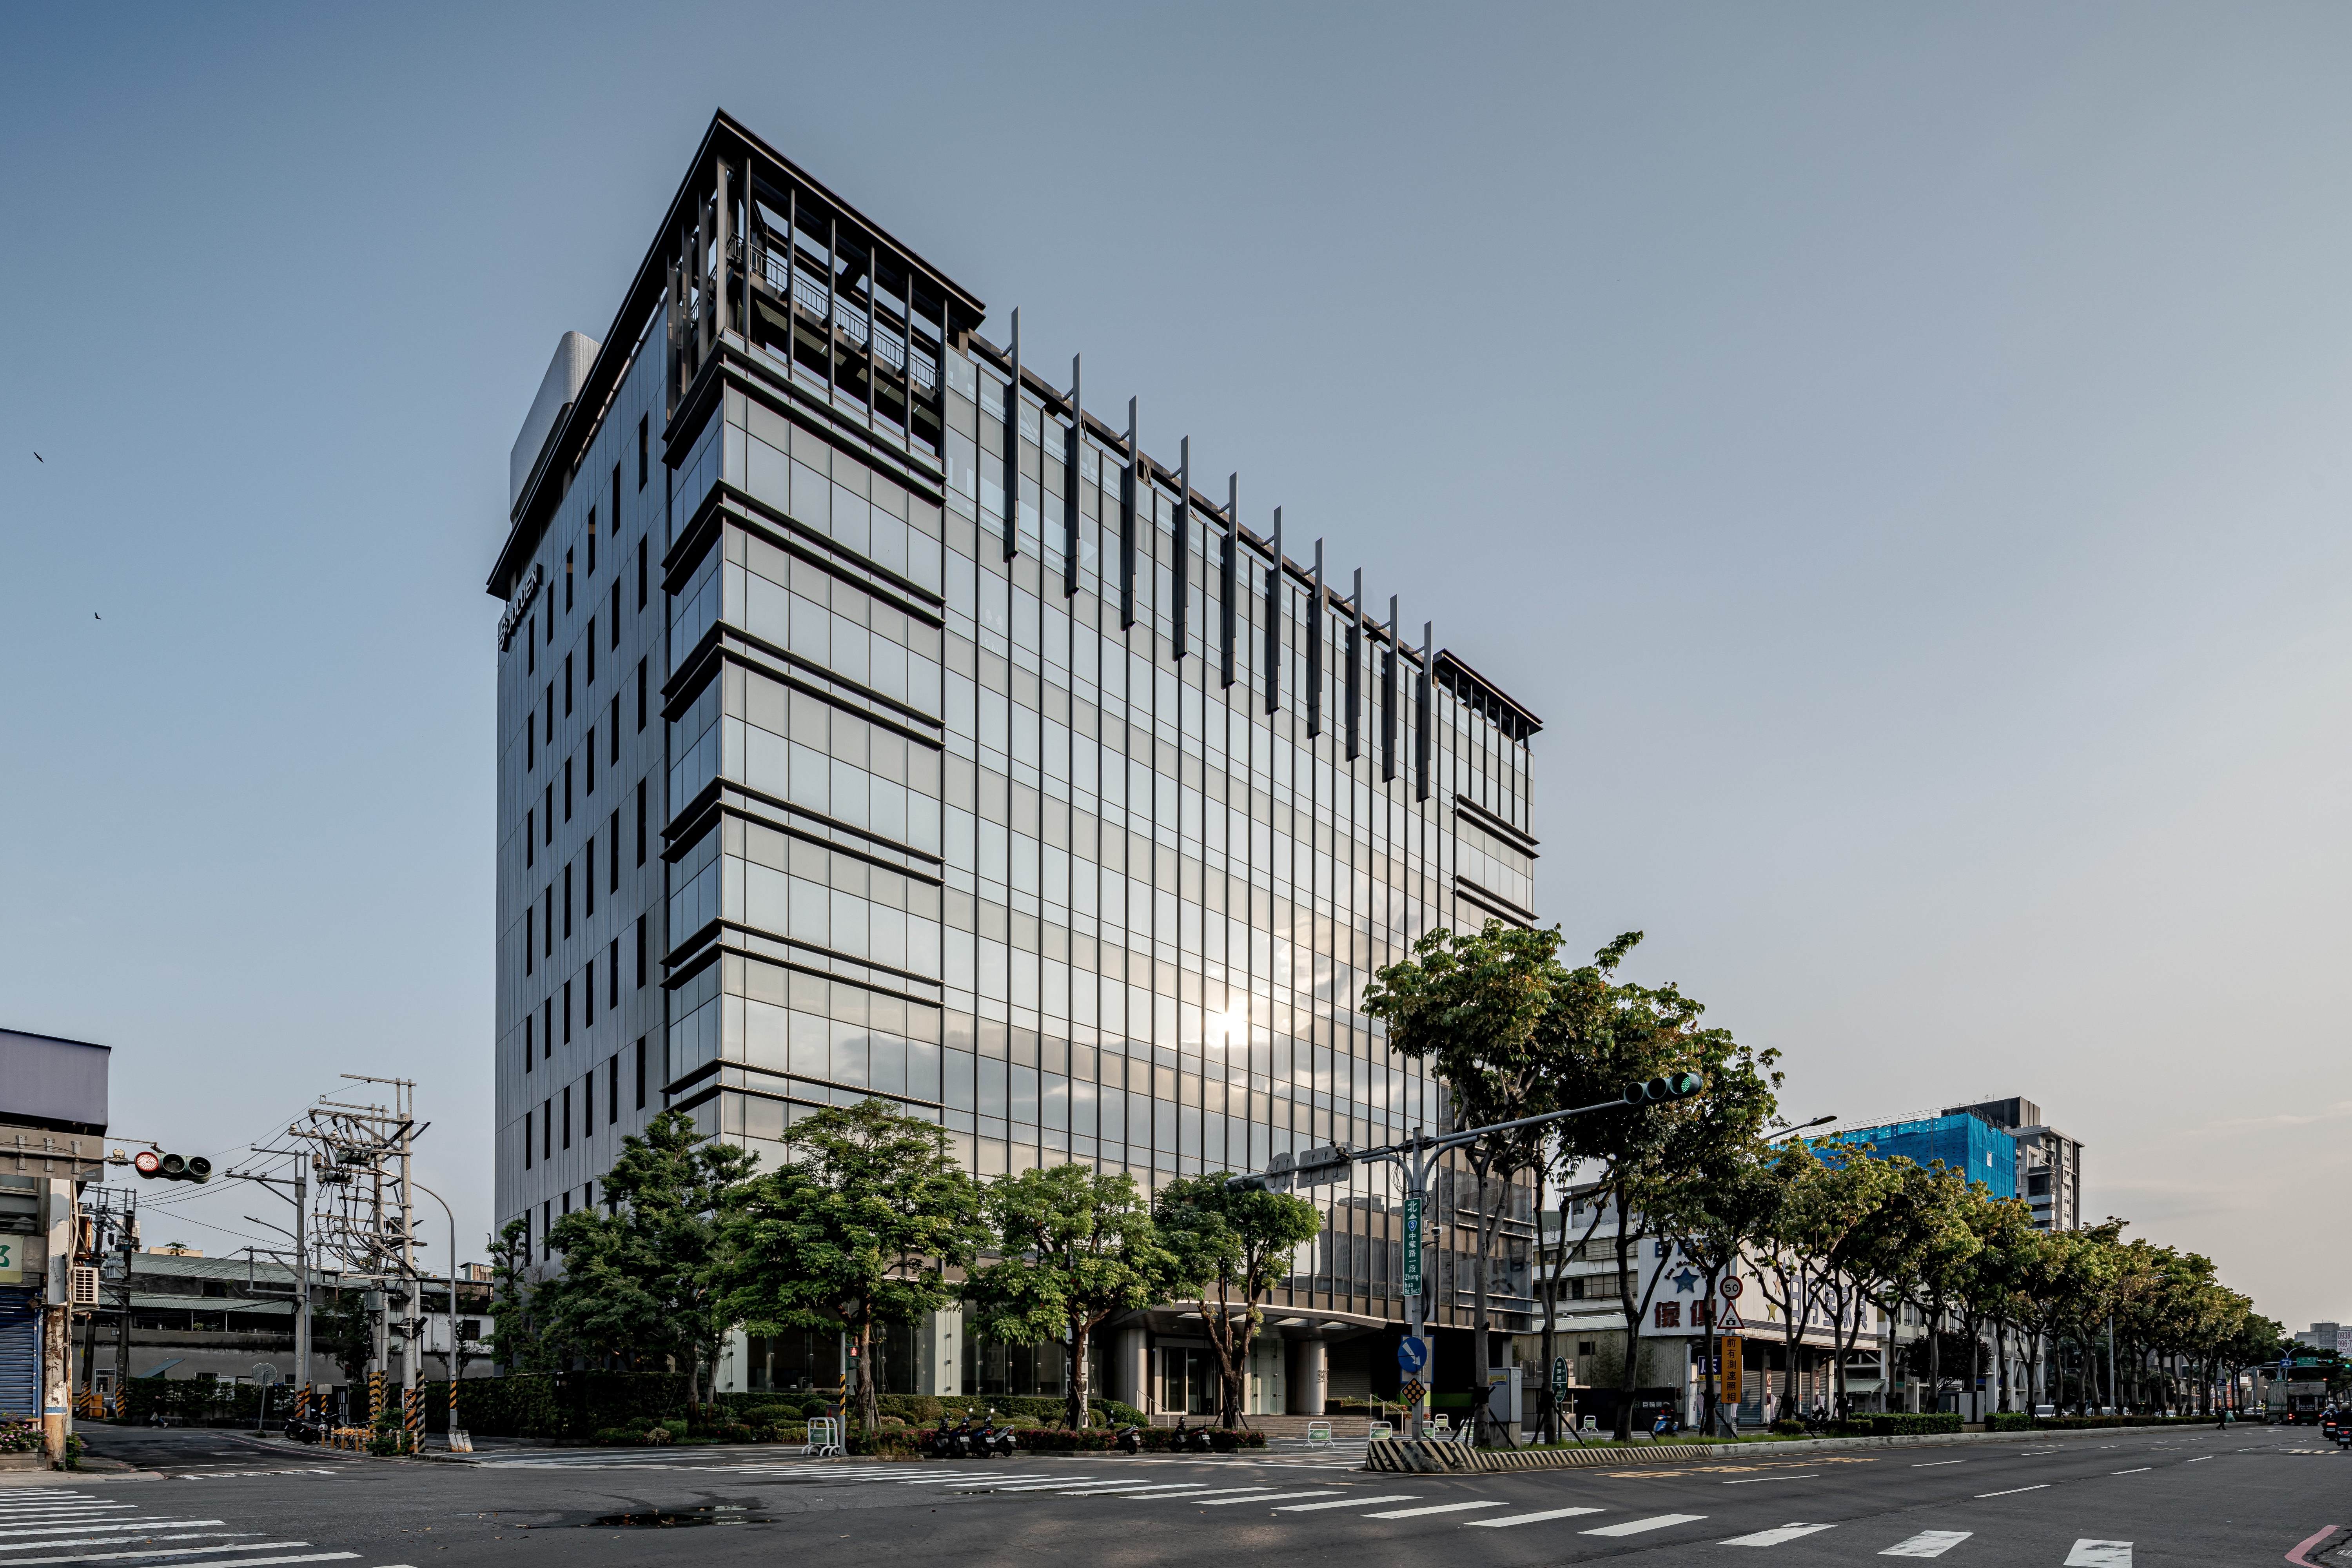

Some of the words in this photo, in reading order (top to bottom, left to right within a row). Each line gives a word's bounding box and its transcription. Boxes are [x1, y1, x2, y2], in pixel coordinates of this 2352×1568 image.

[507, 563, 540, 635] JULUEN
[1408, 1201, 1417, 1212] 北
[1725, 1284, 1739, 1292] 50
[1727, 1338, 1737, 1402] 前有測速照相
